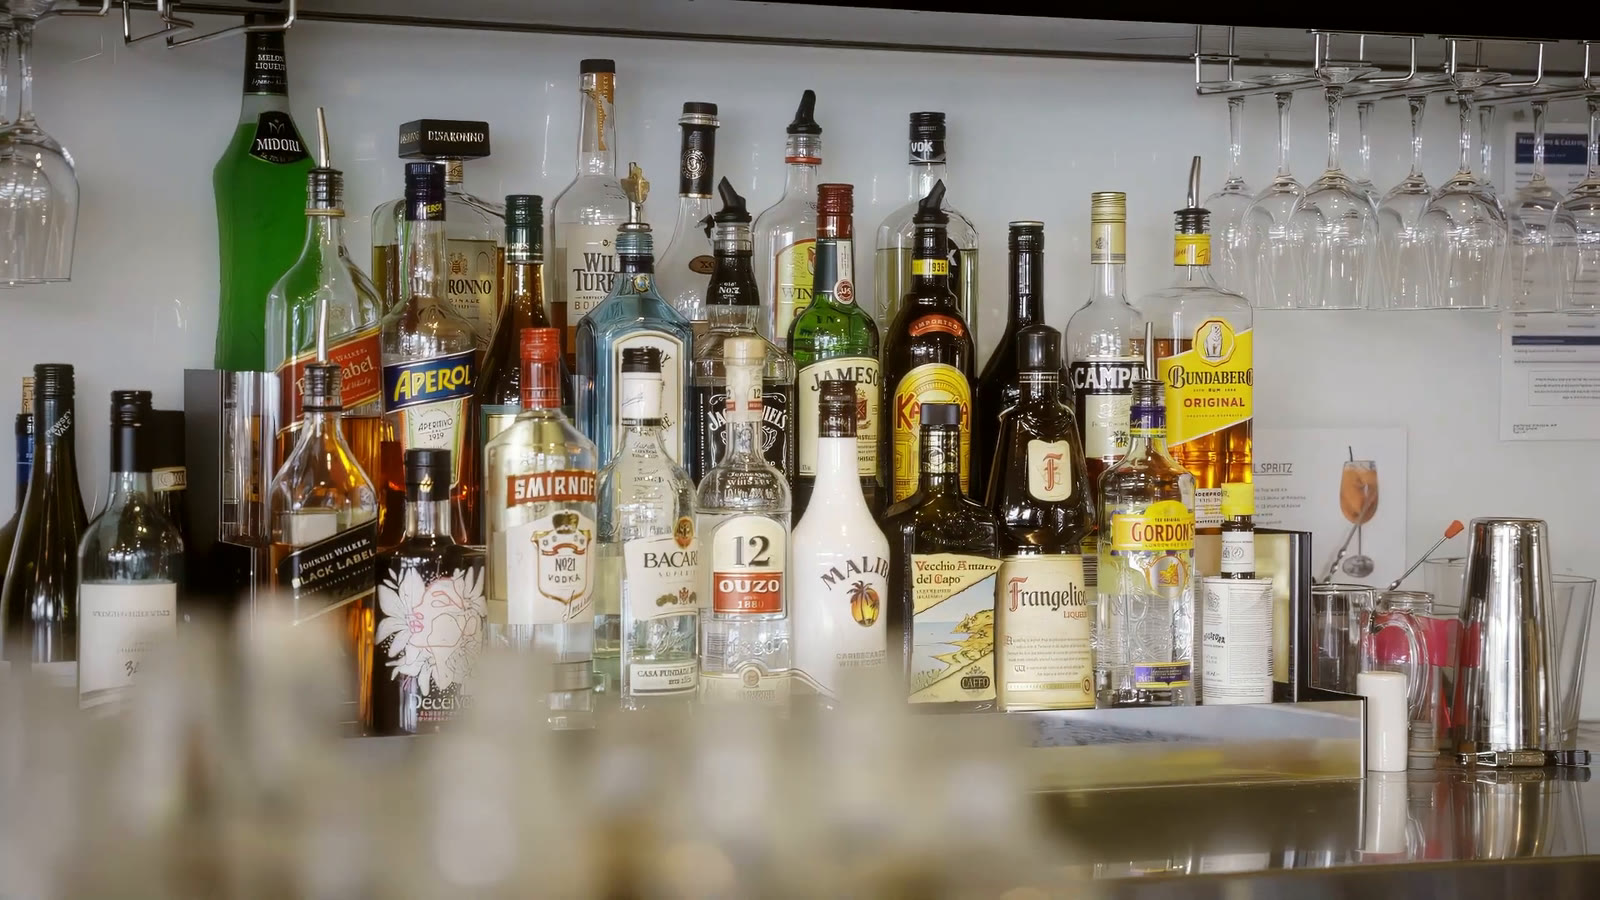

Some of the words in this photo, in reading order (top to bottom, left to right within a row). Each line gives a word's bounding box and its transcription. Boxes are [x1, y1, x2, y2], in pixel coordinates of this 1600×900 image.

[427, 130, 485, 143] DISARONNO
[256, 137, 302, 152] MIDORI
[911, 141, 934, 153] VOK
[583, 252, 617, 273] WIL
[448, 279, 492, 295] RONNO
[572, 268, 617, 294] TURK
[914, 320, 958, 330] IMPORTED
[342, 355, 374, 380] abel
[393, 364, 471, 402] APEROL
[1074, 366, 1148, 390] CAMPA
[1183, 397, 1246, 408] ORIGINAL
[418, 417, 454, 432] APERITIVO
[1260, 462, 1293, 474] SPRITZ
[1131, 521, 1195, 544] GORDON'S
[731, 534, 772, 568] 12
[299, 551, 335, 574] JOHNNIE
[300, 564, 335, 585] LACK
[336, 548, 377, 570] LABEL
[915, 560, 956, 571] Vecchio
[956, 560, 997, 571] Amaro
[548, 573, 582, 584] VODKA
[718, 579, 780, 593] OUZO
[916, 573, 933, 585] del
[934, 573, 961, 587] Capo
[961, 677, 989, 688] CAFFO
